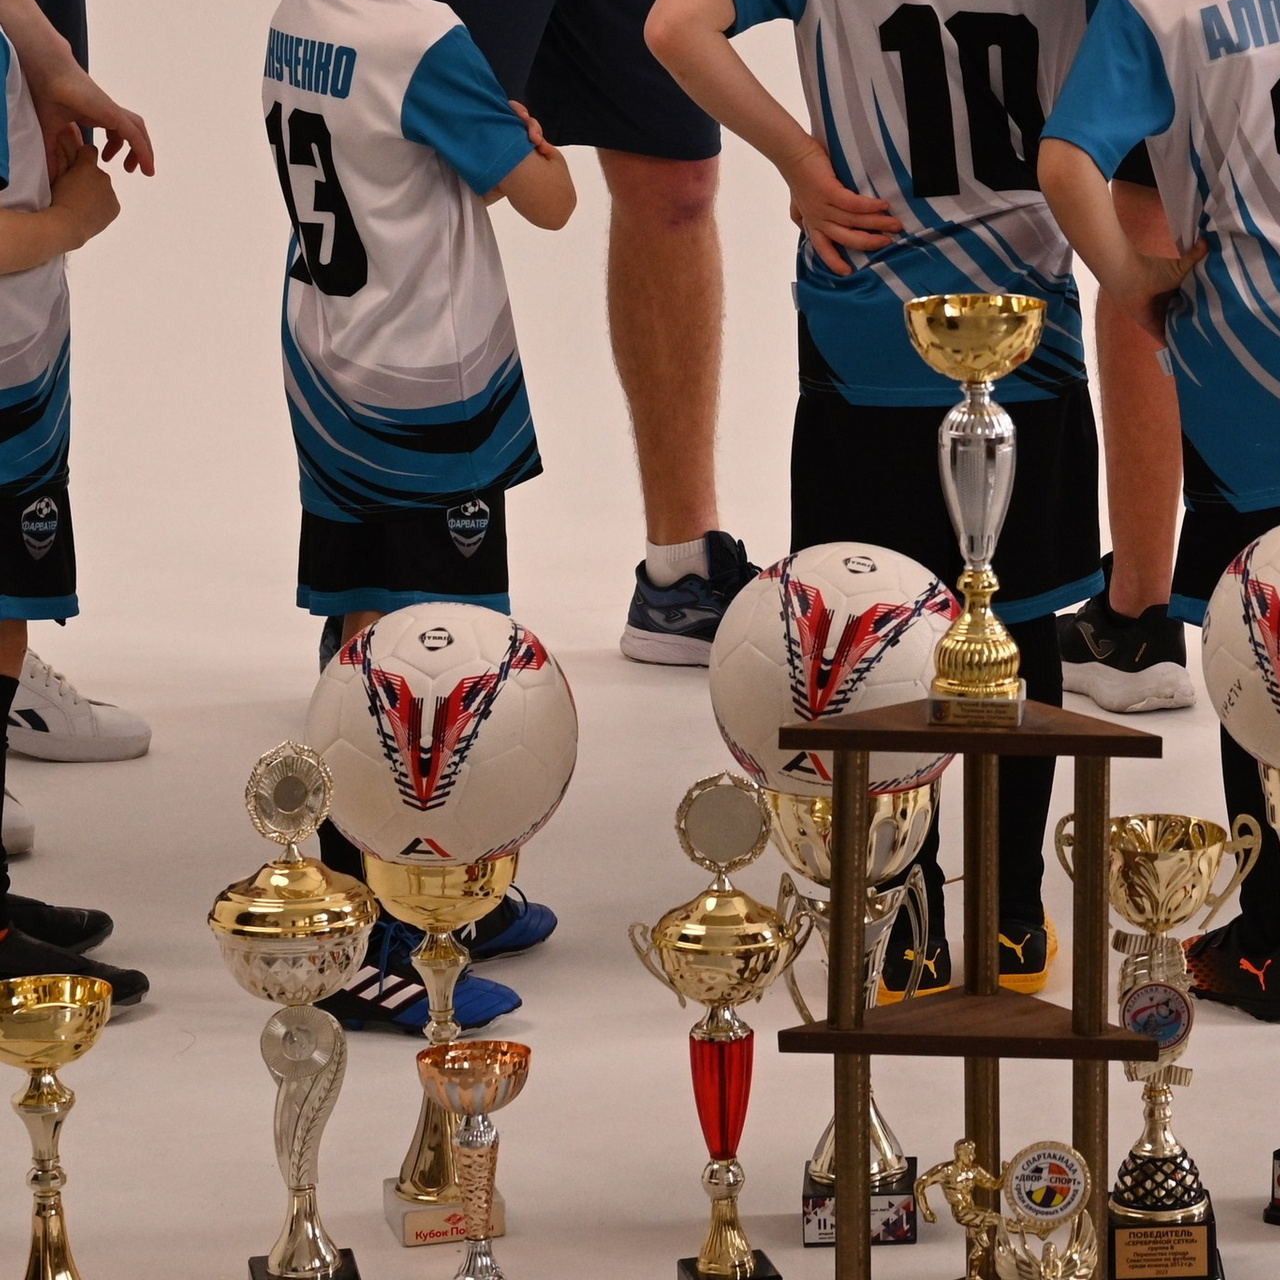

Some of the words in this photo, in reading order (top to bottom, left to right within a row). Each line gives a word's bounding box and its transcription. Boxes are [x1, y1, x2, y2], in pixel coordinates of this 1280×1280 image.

[878, 2, 1046, 198] 10
[265, 100, 368, 298] 13
[1021, 1152, 1078, 1175] СПАРТАКИАДА
[415, 1229, 448, 1242] Кубок
[1129, 1229, 1193, 1239] ПОБЕДИТЕЛЬ
